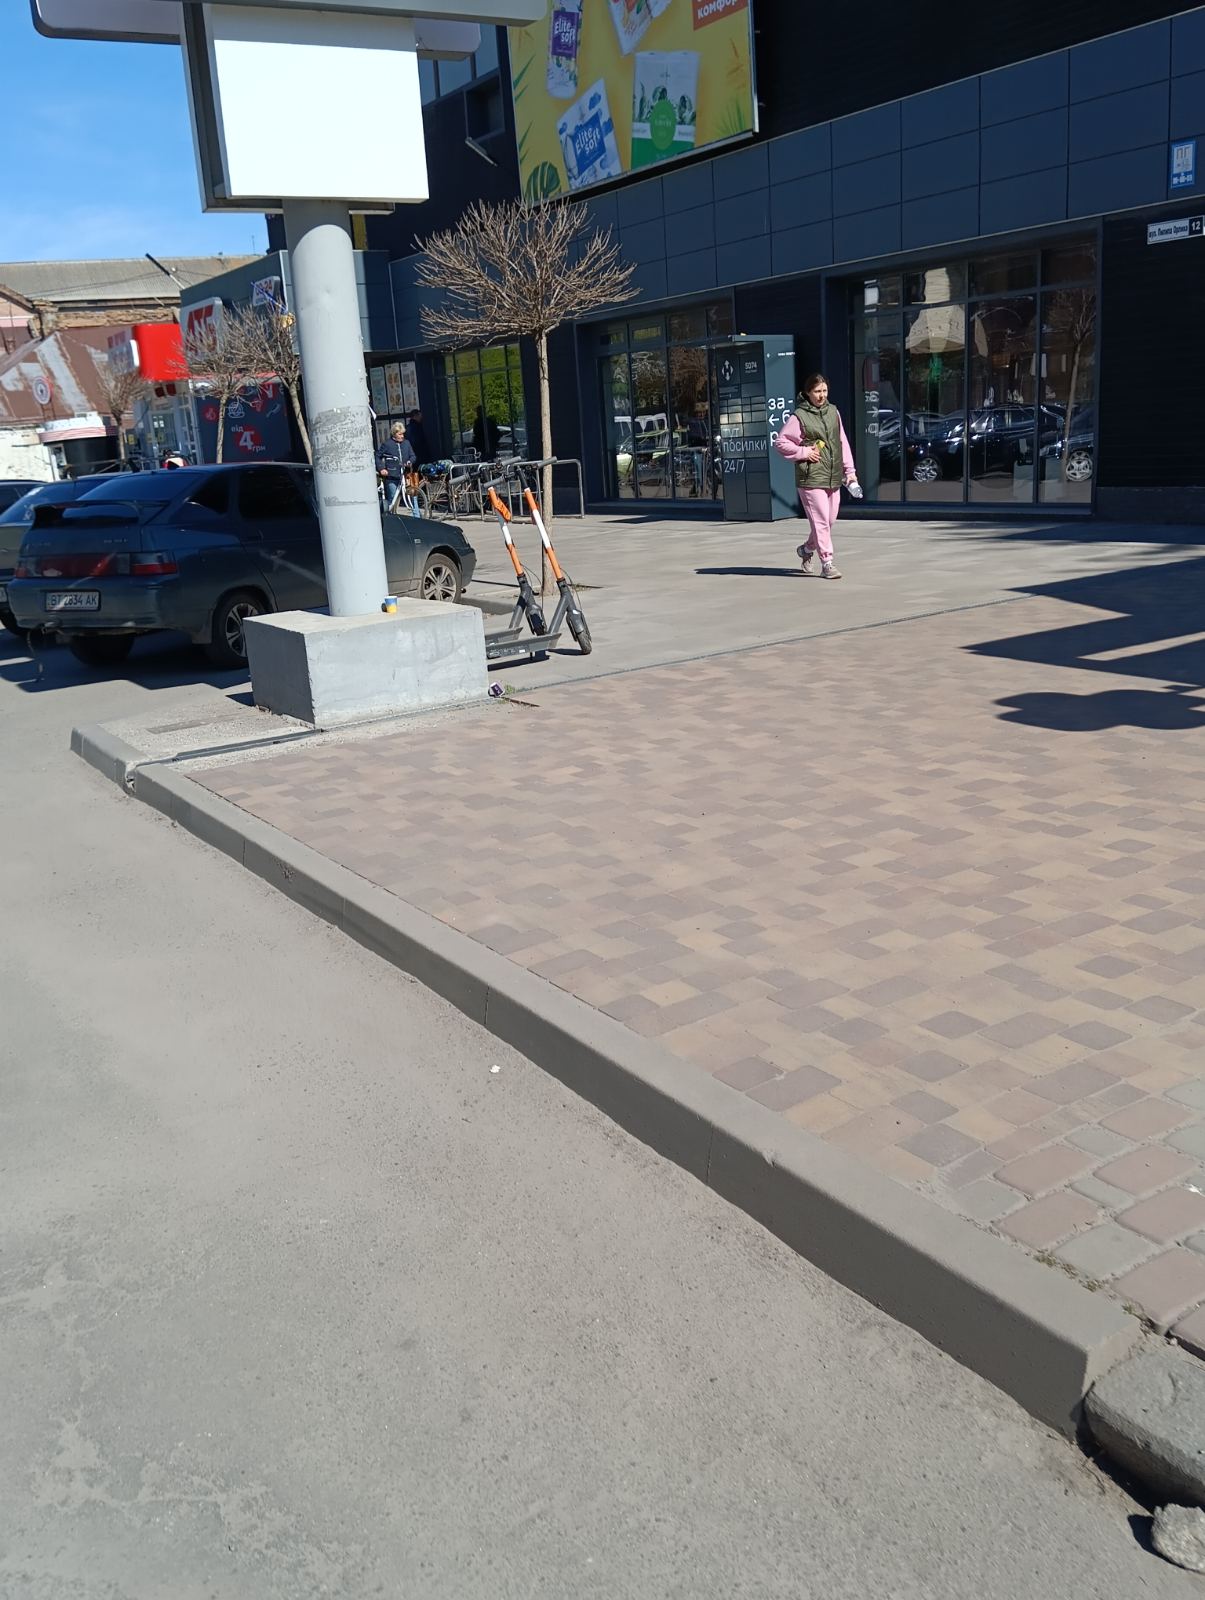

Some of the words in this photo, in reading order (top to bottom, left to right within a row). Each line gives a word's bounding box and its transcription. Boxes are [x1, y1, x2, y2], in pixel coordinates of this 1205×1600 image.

[554, 18, 572, 35] Elite
[561, 28, 576, 45] soft
[575, 127, 593, 154] Elite
[584, 127, 600, 154] soft
[1191, 220, 1201, 231] 12
[723, 439, 767, 452] посилки
[723, 459, 745, 474] 24/7
